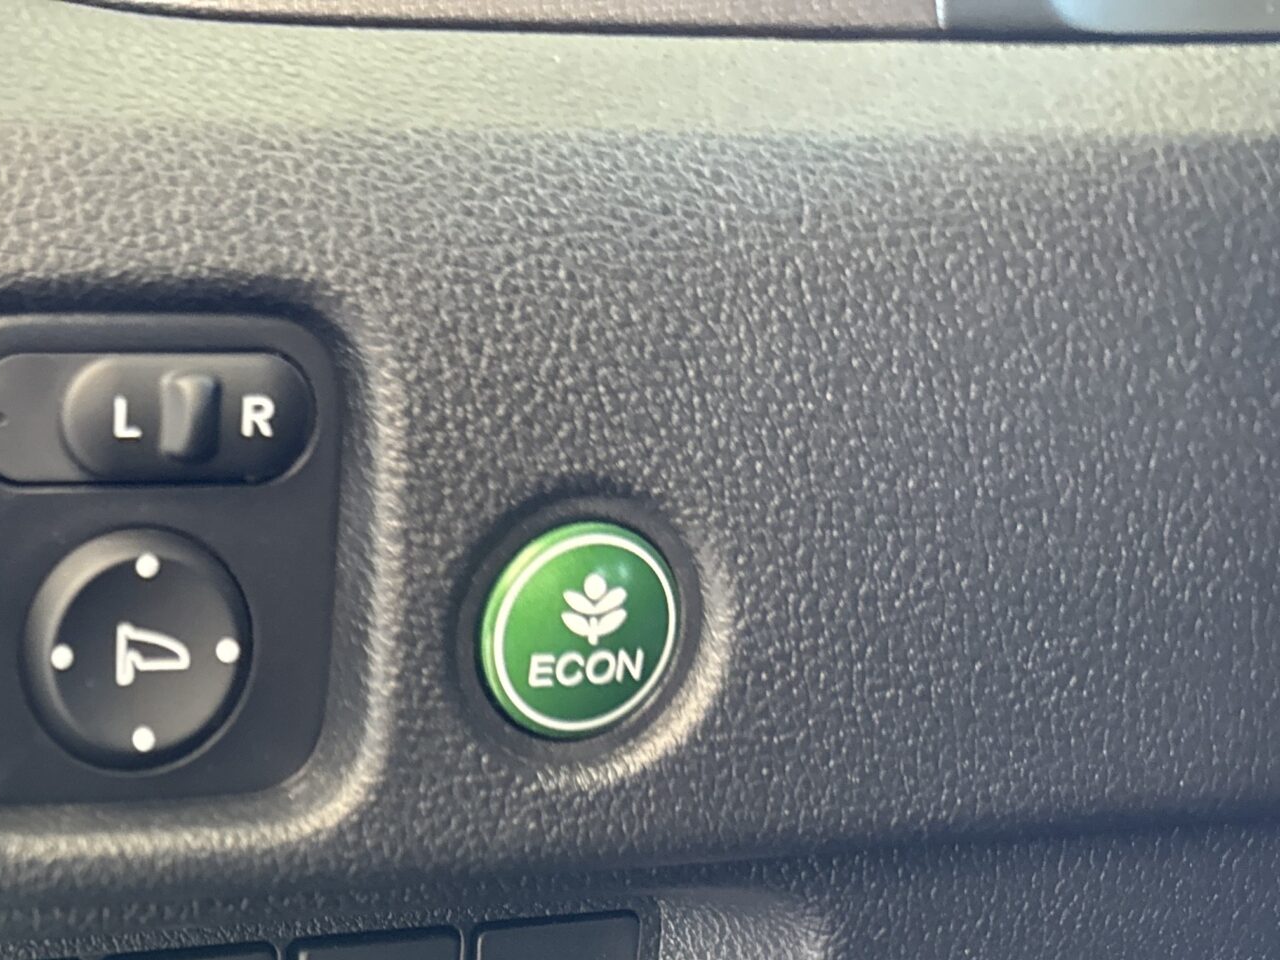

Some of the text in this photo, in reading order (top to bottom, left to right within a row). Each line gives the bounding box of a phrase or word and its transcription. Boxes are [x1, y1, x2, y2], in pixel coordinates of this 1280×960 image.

[113, 395, 142, 438] L
[240, 394, 275, 438] R
[527, 648, 645, 688] ECON
